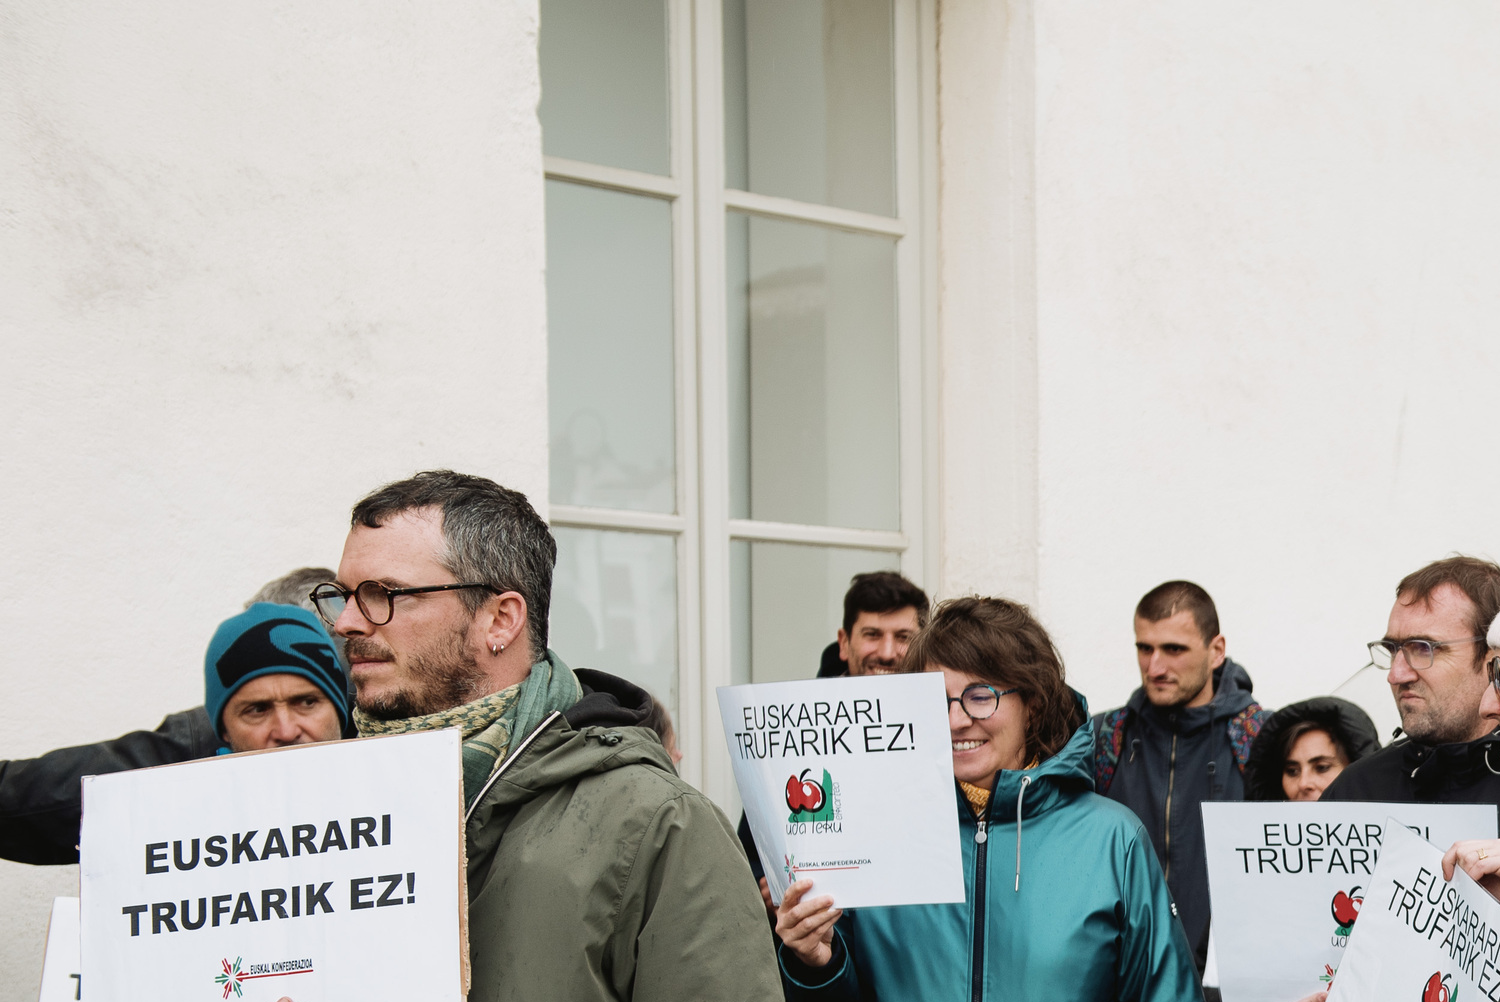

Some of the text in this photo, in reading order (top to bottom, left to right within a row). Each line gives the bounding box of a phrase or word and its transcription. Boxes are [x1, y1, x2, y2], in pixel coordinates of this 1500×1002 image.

[743, 698, 882, 731] EUSKARARI
[734, 722, 916, 760] TRUFARIK EZ!
[145, 813, 393, 875] EUSKARARI
[1263, 823, 1430, 847] EUSKARI
[821, 858, 872, 867] KONFEDERAZIOA
[1236, 848, 1378, 875] TRUFARI
[122, 871, 417, 938] TRUFARIK EZ!
[1331, 927, 1348, 948] ud
[1388, 879, 1481, 982] TRUFARIK
[250, 958, 313, 975] EUSKAL KONFEDERAZIOA
